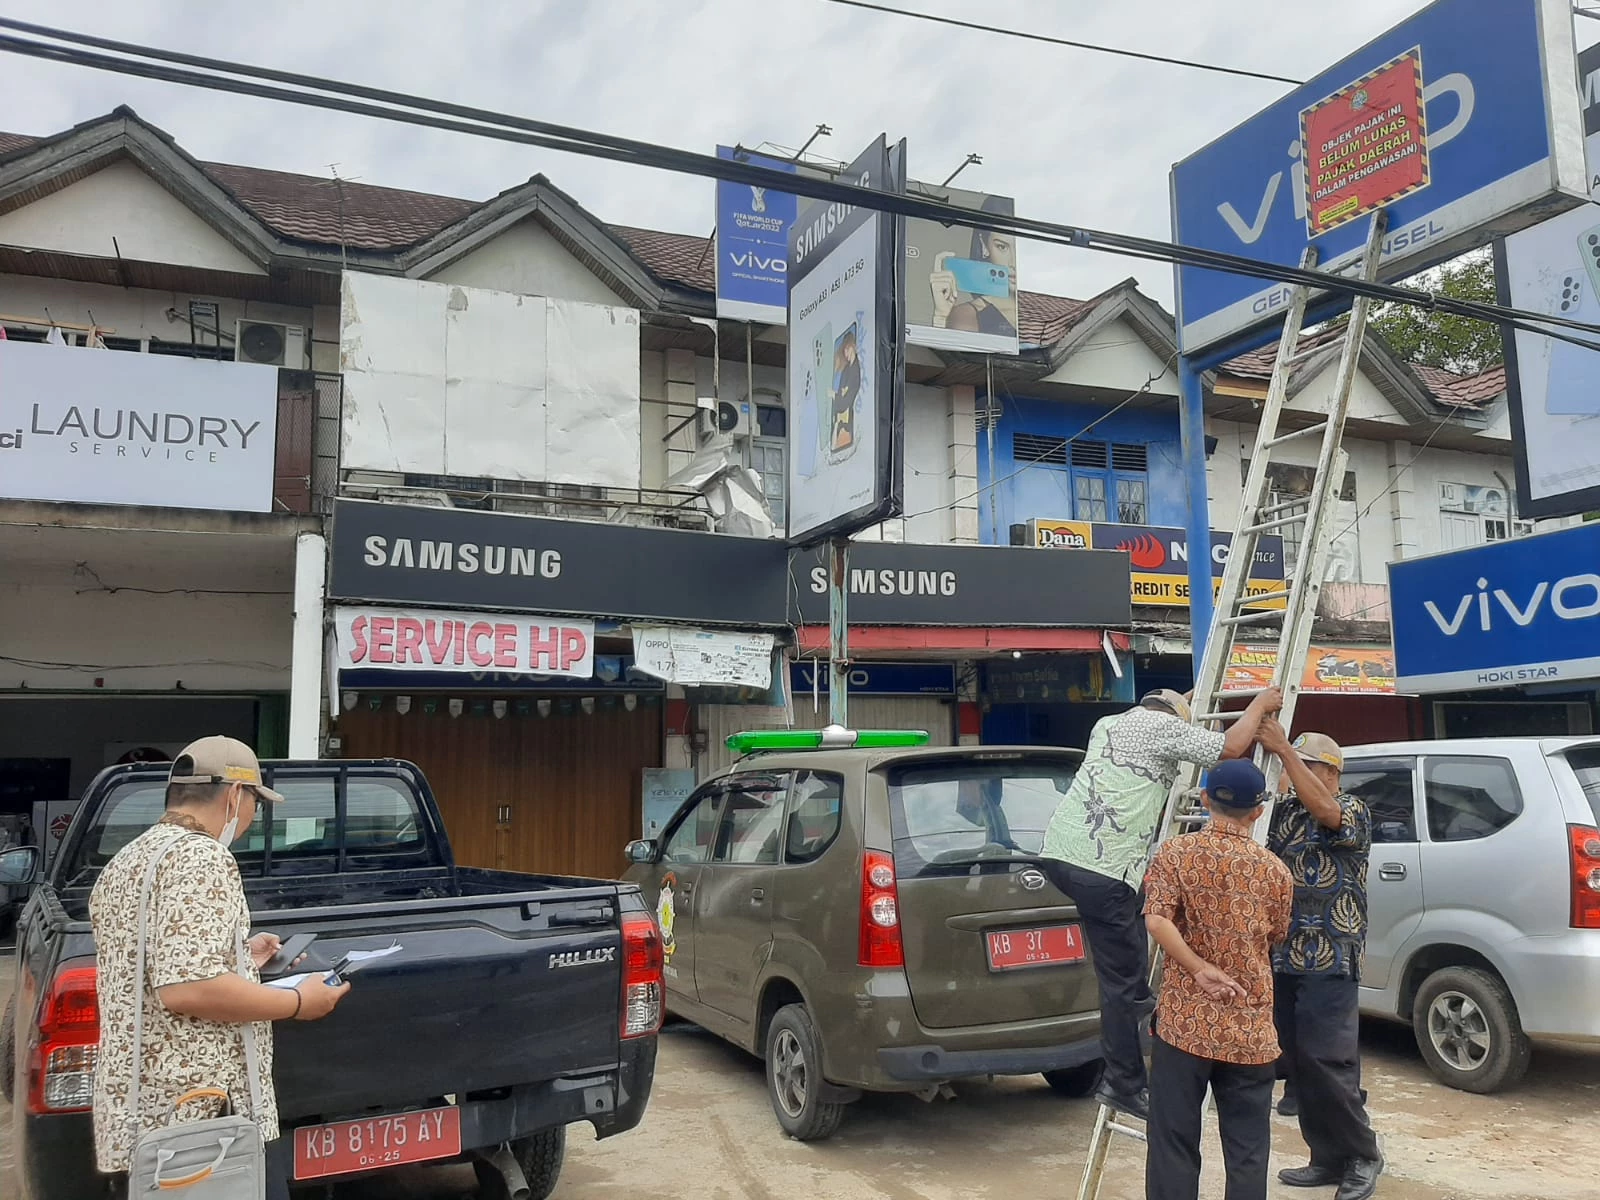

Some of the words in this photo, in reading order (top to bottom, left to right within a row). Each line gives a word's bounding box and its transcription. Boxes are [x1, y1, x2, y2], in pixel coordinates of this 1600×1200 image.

[1319, 139, 1361, 169] BELUM
[1363, 116, 1406, 146] LUNAS
[1321, 130, 1352, 153] OBJEK
[1354, 112, 1385, 136] PAJAK
[1387, 103, 1402, 118] INI
[1217, 72, 1475, 245] vio
[1313, 178, 1346, 202] (DALAM
[1348, 142, 1418, 182] PENGAWASAN)
[1317, 158, 1356, 185] PAJAK
[1359, 130, 1411, 164] DAERAH
[729, 251, 788, 272] vivo
[799, 300, 818, 321] Galaxy
[818, 288, 828, 304] A33
[31, 402, 261, 450] LAUNDRY
[69, 441, 217, 463] SERVICE
[1039, 528, 1085, 547] Dana
[1170, 541, 1230, 564] NC
[364, 535, 562, 578] SAMSUNG
[810, 567, 957, 596] SMSUNG
[1424, 573, 1600, 637] vivo
[349, 614, 518, 668] SERVICE
[528, 624, 587, 671] HP
[645, 640, 669, 649] OPPO
[801, 665, 869, 686] vio
[1477, 669, 1514, 684] HOKI
[1517, 667, 1558, 680] STAR
[548, 946, 616, 969] HILUX
[993, 934, 1011, 955] KB
[1026, 931, 1042, 951] 37
[1066, 927, 1075, 947] A
[306, 1127, 336, 1160] KB
[348, 1116, 408, 1153] 8175
[418, 1111, 444, 1142] AY
